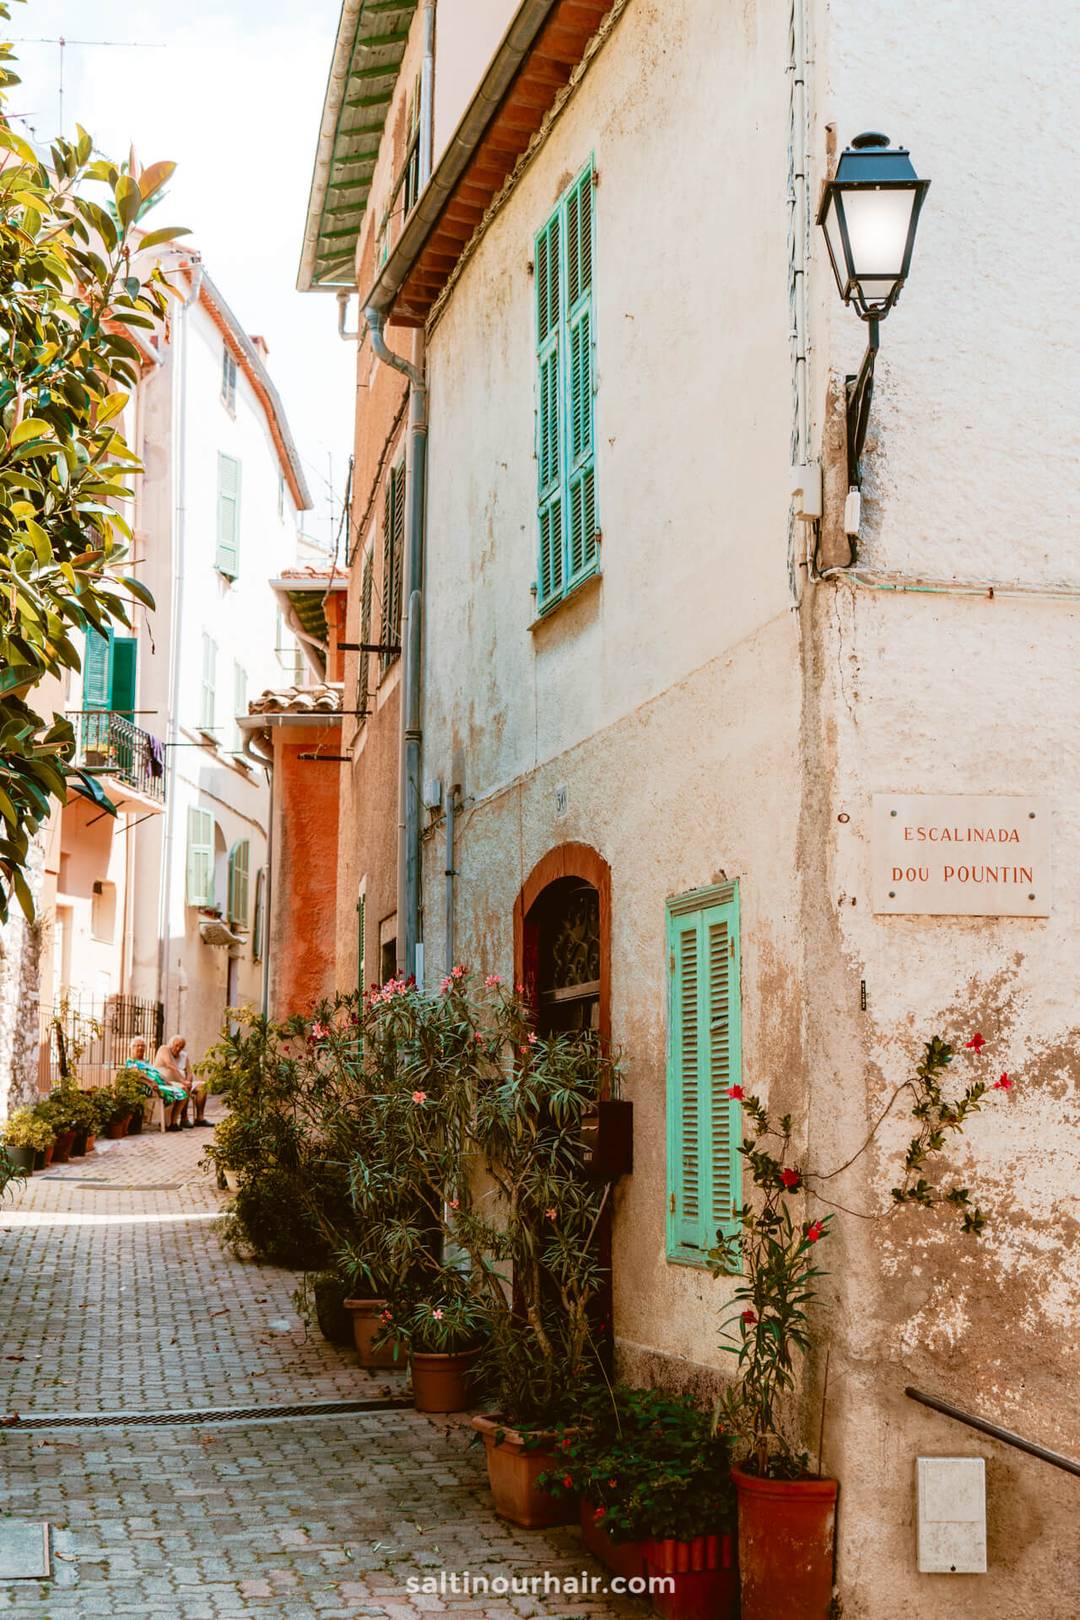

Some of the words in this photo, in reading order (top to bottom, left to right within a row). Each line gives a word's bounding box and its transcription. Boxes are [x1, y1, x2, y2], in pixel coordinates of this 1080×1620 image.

[903, 826, 1021, 843] ESCALINADA
[891, 866, 929, 882] DOU
[943, 865, 1034, 884] POUNTIN
